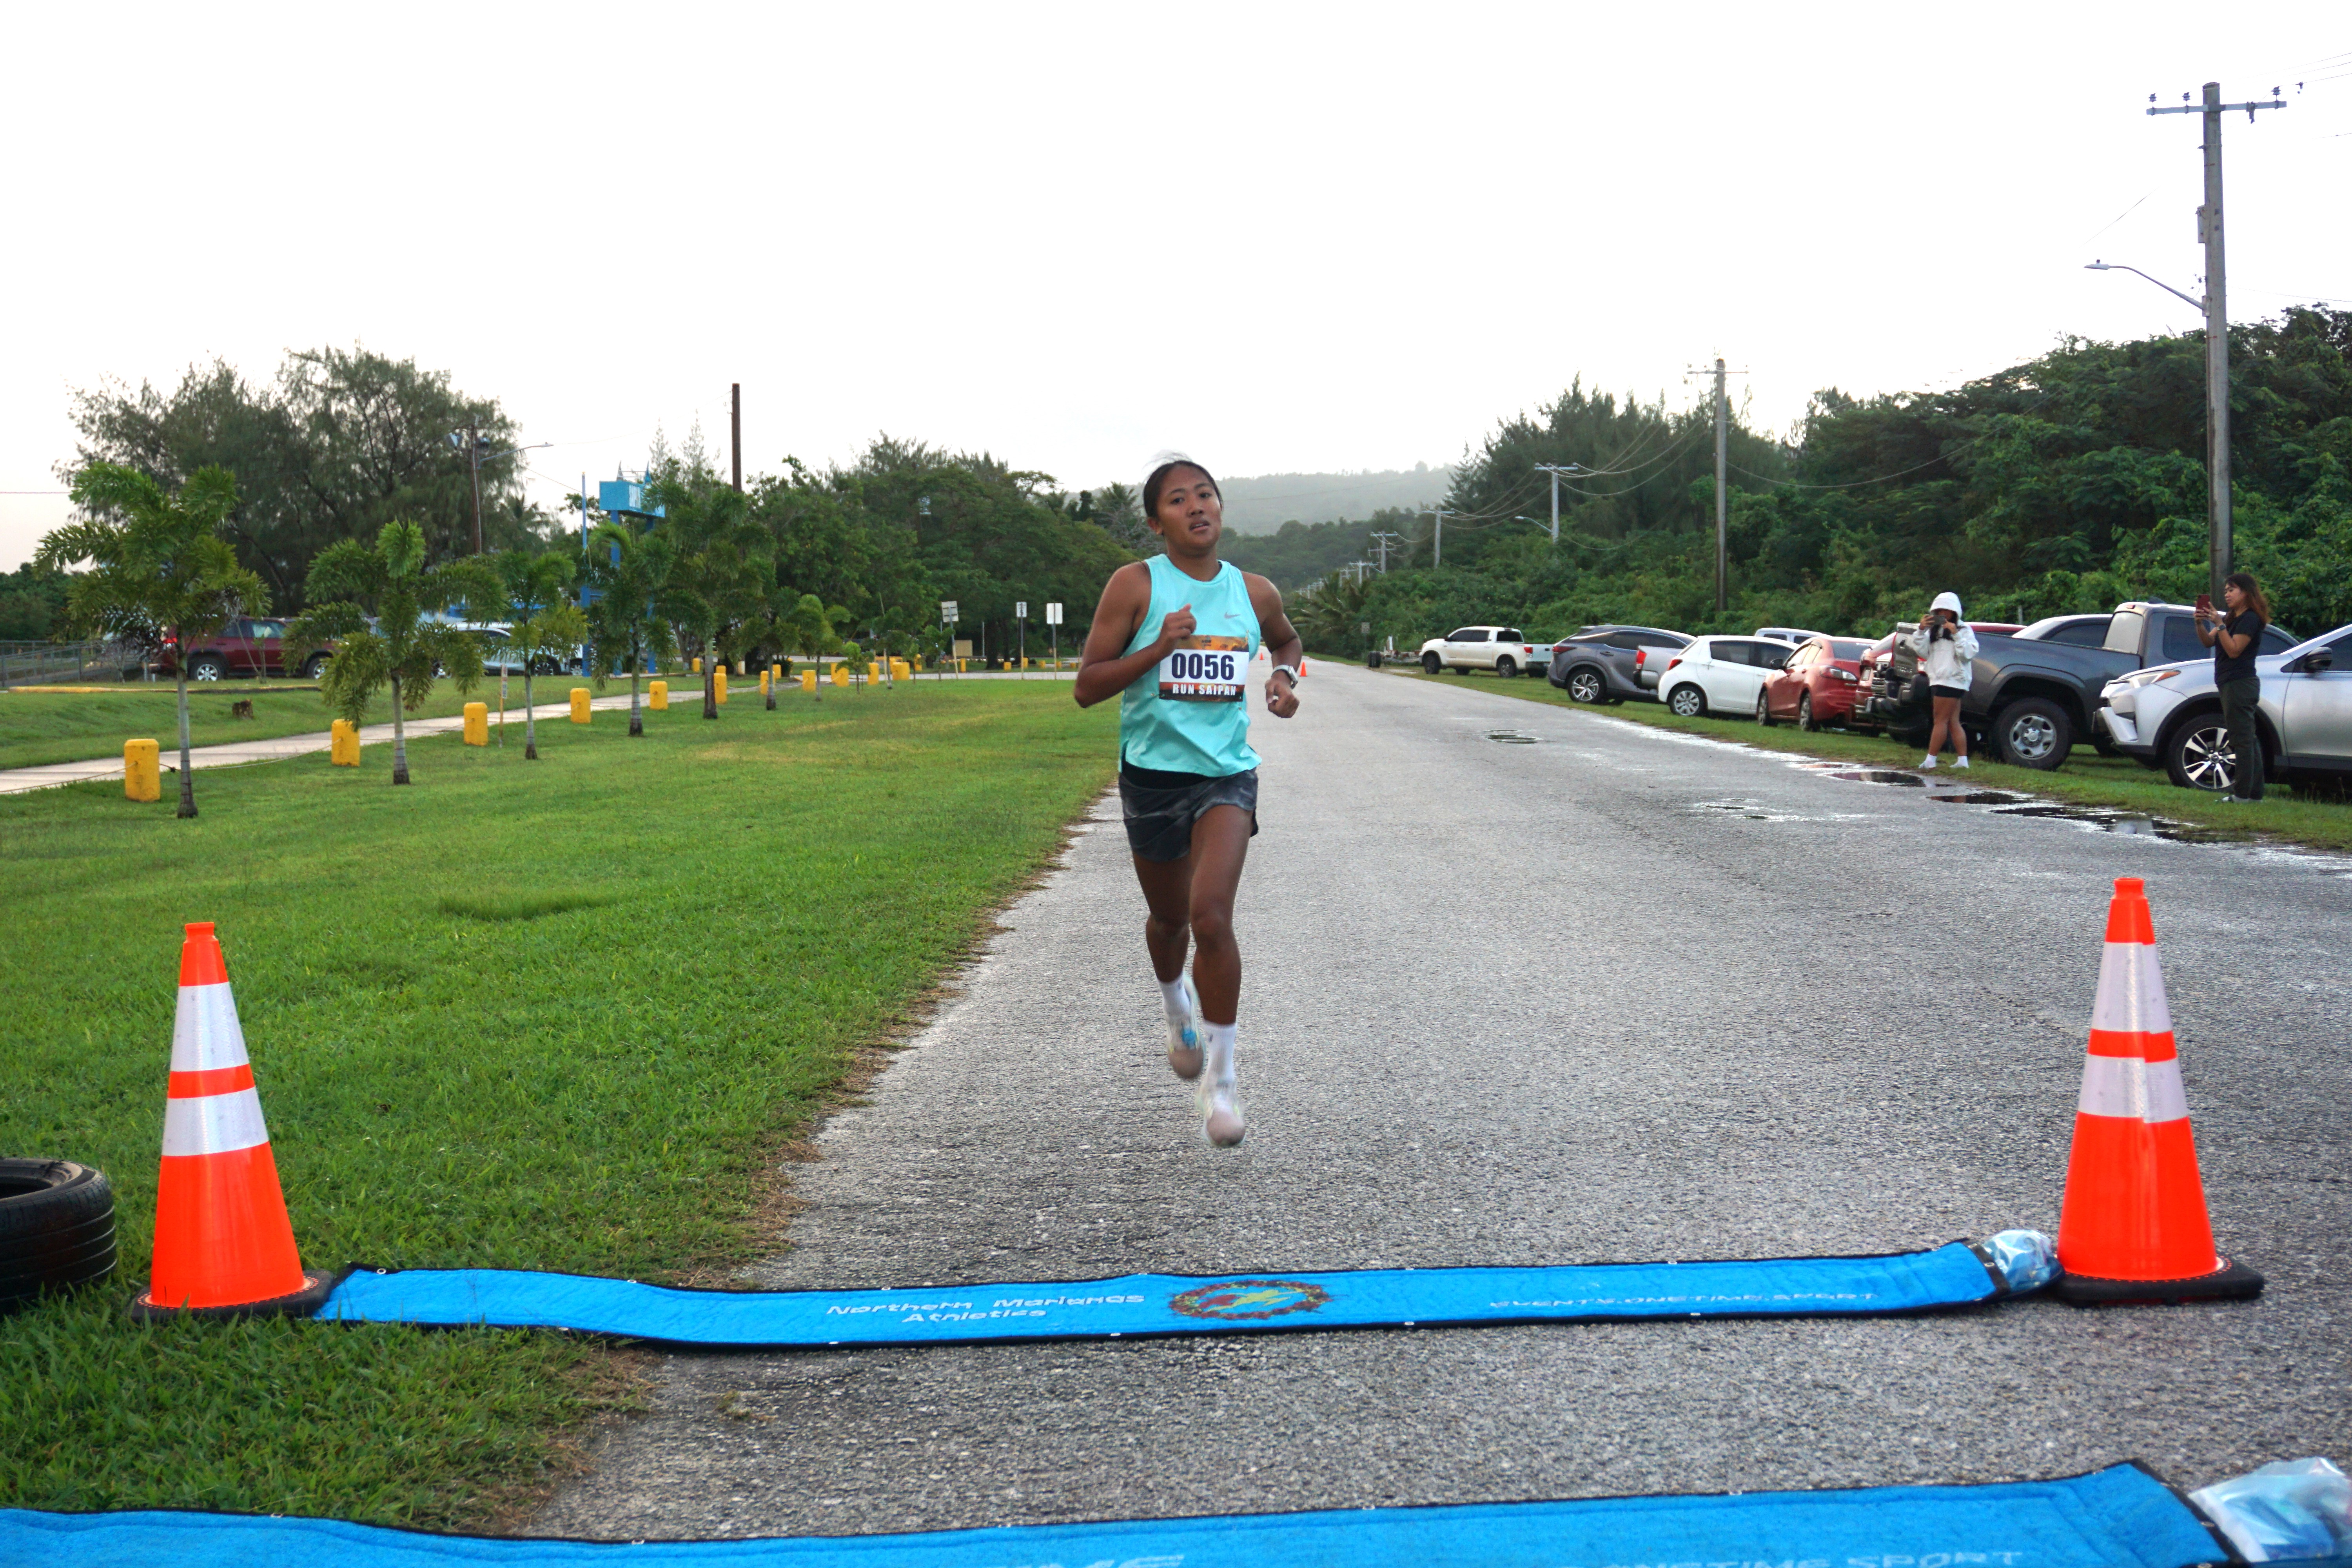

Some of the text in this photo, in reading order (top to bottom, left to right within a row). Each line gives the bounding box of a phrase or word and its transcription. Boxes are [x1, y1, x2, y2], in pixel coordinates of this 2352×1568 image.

[1172, 653, 1234, 680] 0056
[1172, 684, 1236, 695] RUN SAIPAN
[826, 1295, 1145, 1315] Northern Marianas
[900, 1310, 1047, 1323] Athletics
